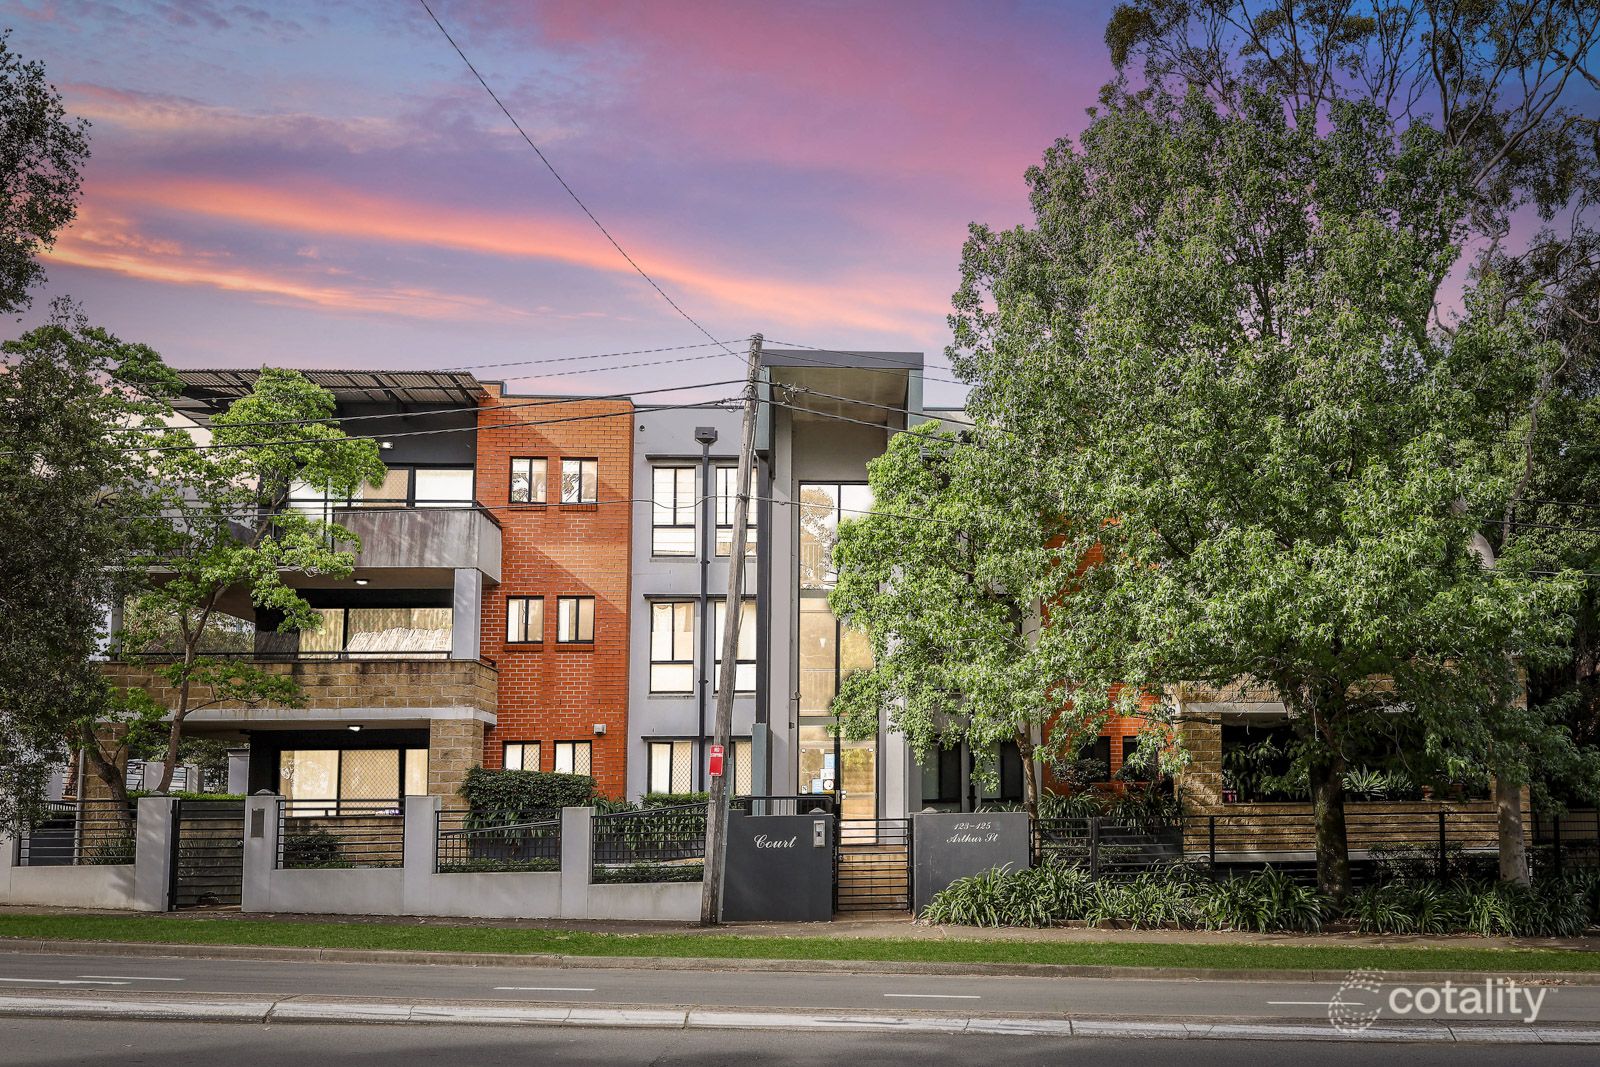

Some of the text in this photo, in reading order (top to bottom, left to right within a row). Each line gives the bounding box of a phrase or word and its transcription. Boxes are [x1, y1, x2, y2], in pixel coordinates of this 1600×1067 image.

[953, 821, 992, 830] 123-125
[753, 834, 798, 849] Court
[946, 832, 999, 843] Arthur St
